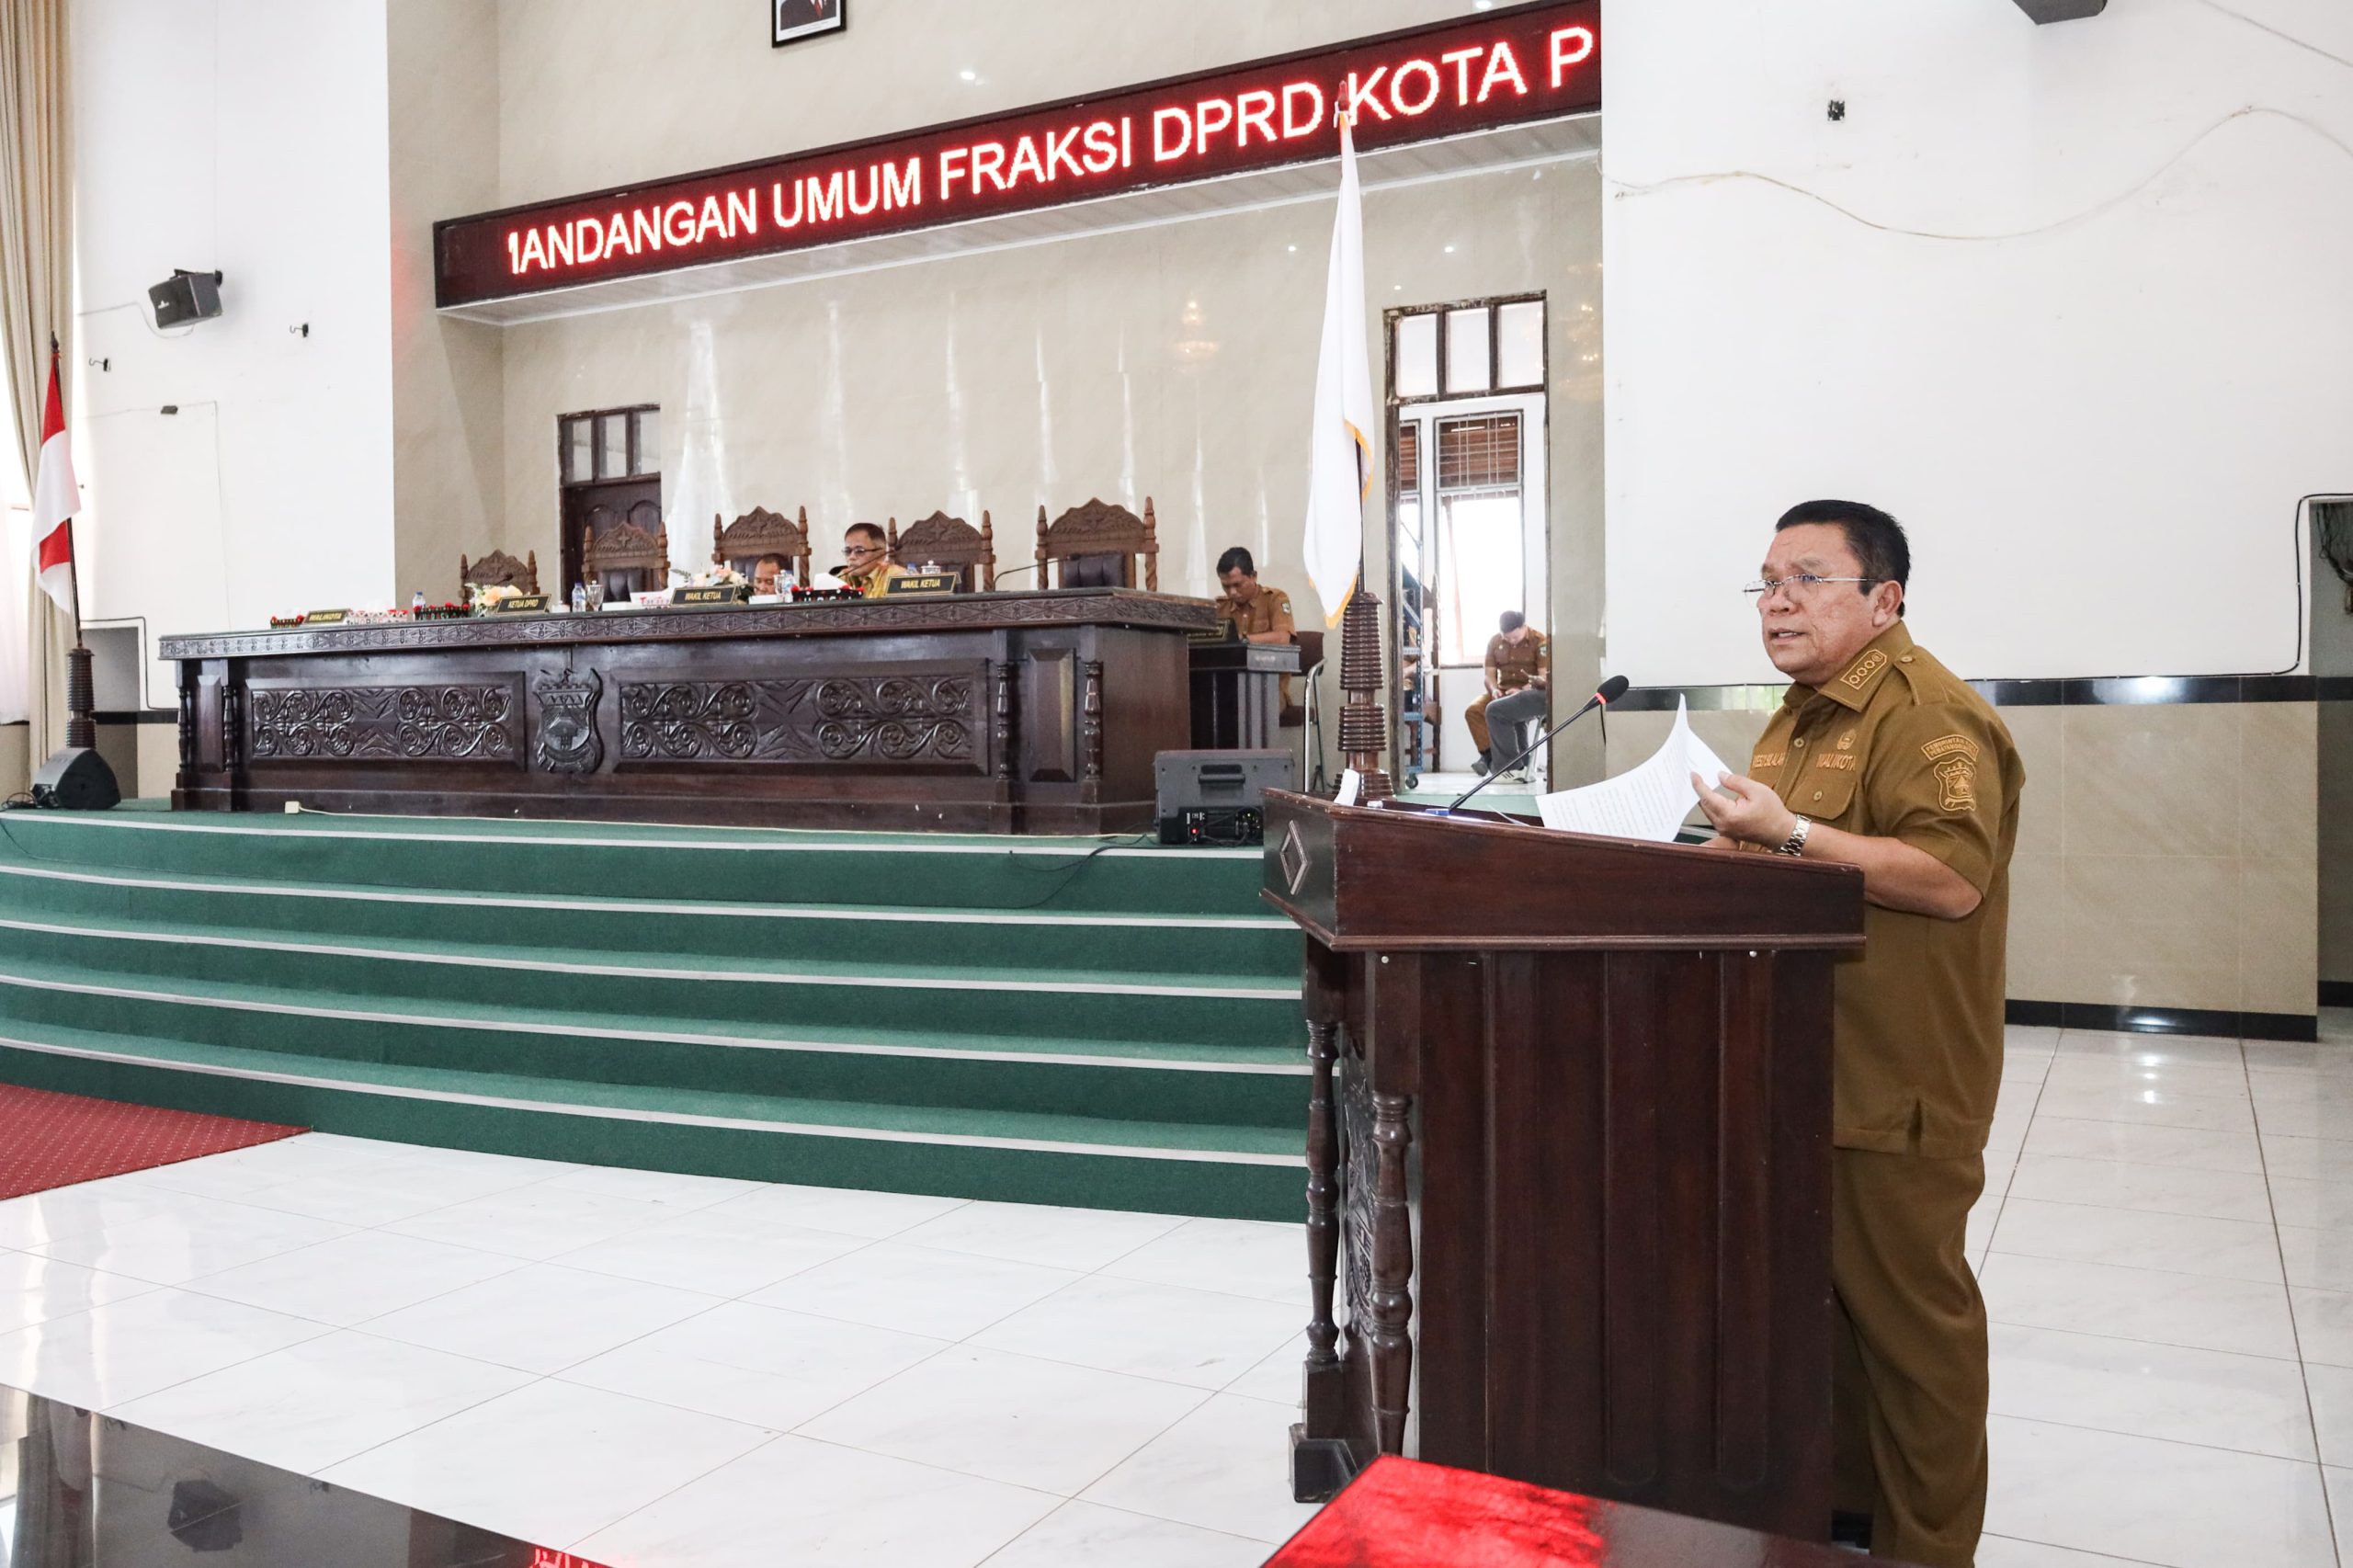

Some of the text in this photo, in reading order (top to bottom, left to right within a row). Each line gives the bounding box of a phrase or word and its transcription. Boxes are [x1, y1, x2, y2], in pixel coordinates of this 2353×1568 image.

[773, 157, 921, 227] UMUM
[939, 117, 1131, 200] FRAKSI
[1154, 82, 1324, 163] DPRD
[1347, 41, 1528, 126] KOTA
[1551, 27, 1594, 88] P
[920, 578, 941, 589] KETUA
[702, 591, 722, 600] KETUA
[1816, 753, 1857, 772] WALIKOTA
